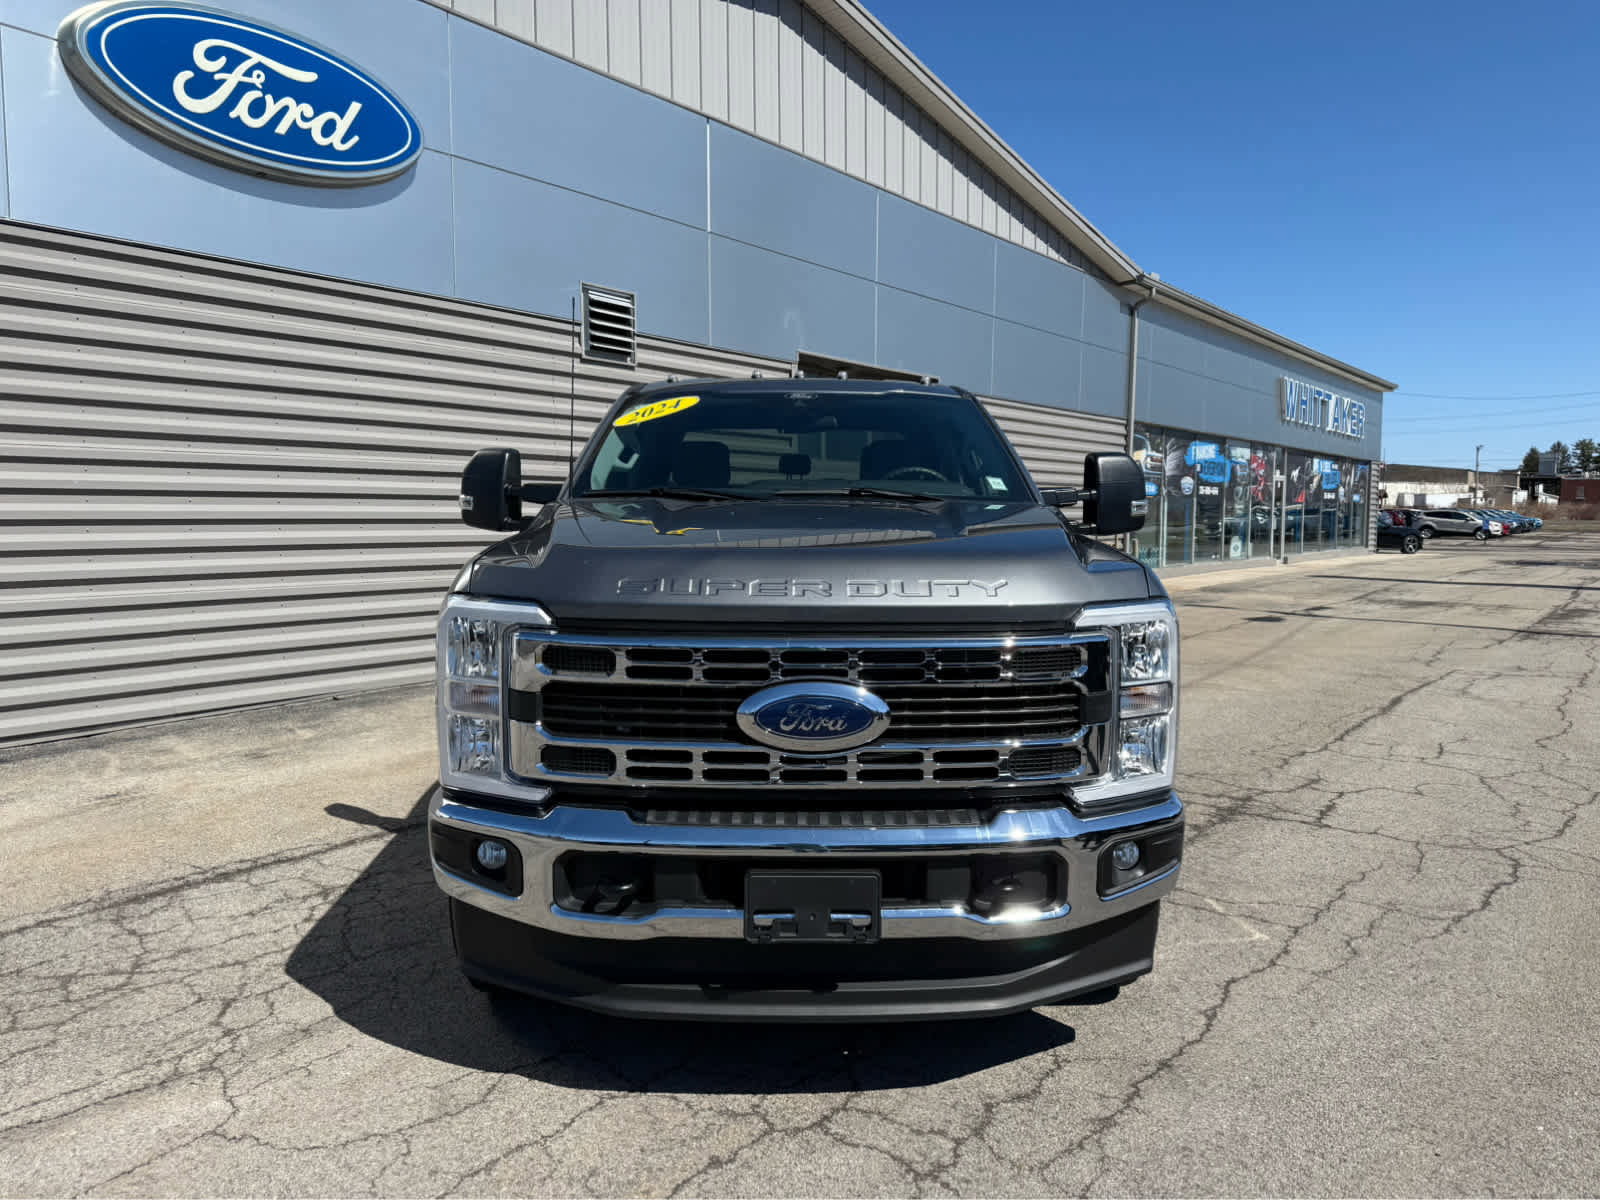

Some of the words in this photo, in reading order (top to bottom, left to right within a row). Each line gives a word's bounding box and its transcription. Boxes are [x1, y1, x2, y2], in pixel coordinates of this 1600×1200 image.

[172, 38, 362, 151] Ford
[625, 399, 682, 424] 2024
[1281, 375, 1366, 439] WHITTAKER
[615, 576, 833, 598] SUPER
[846, 578, 1010, 599] DUTY
[779, 702, 849, 734] Ford
